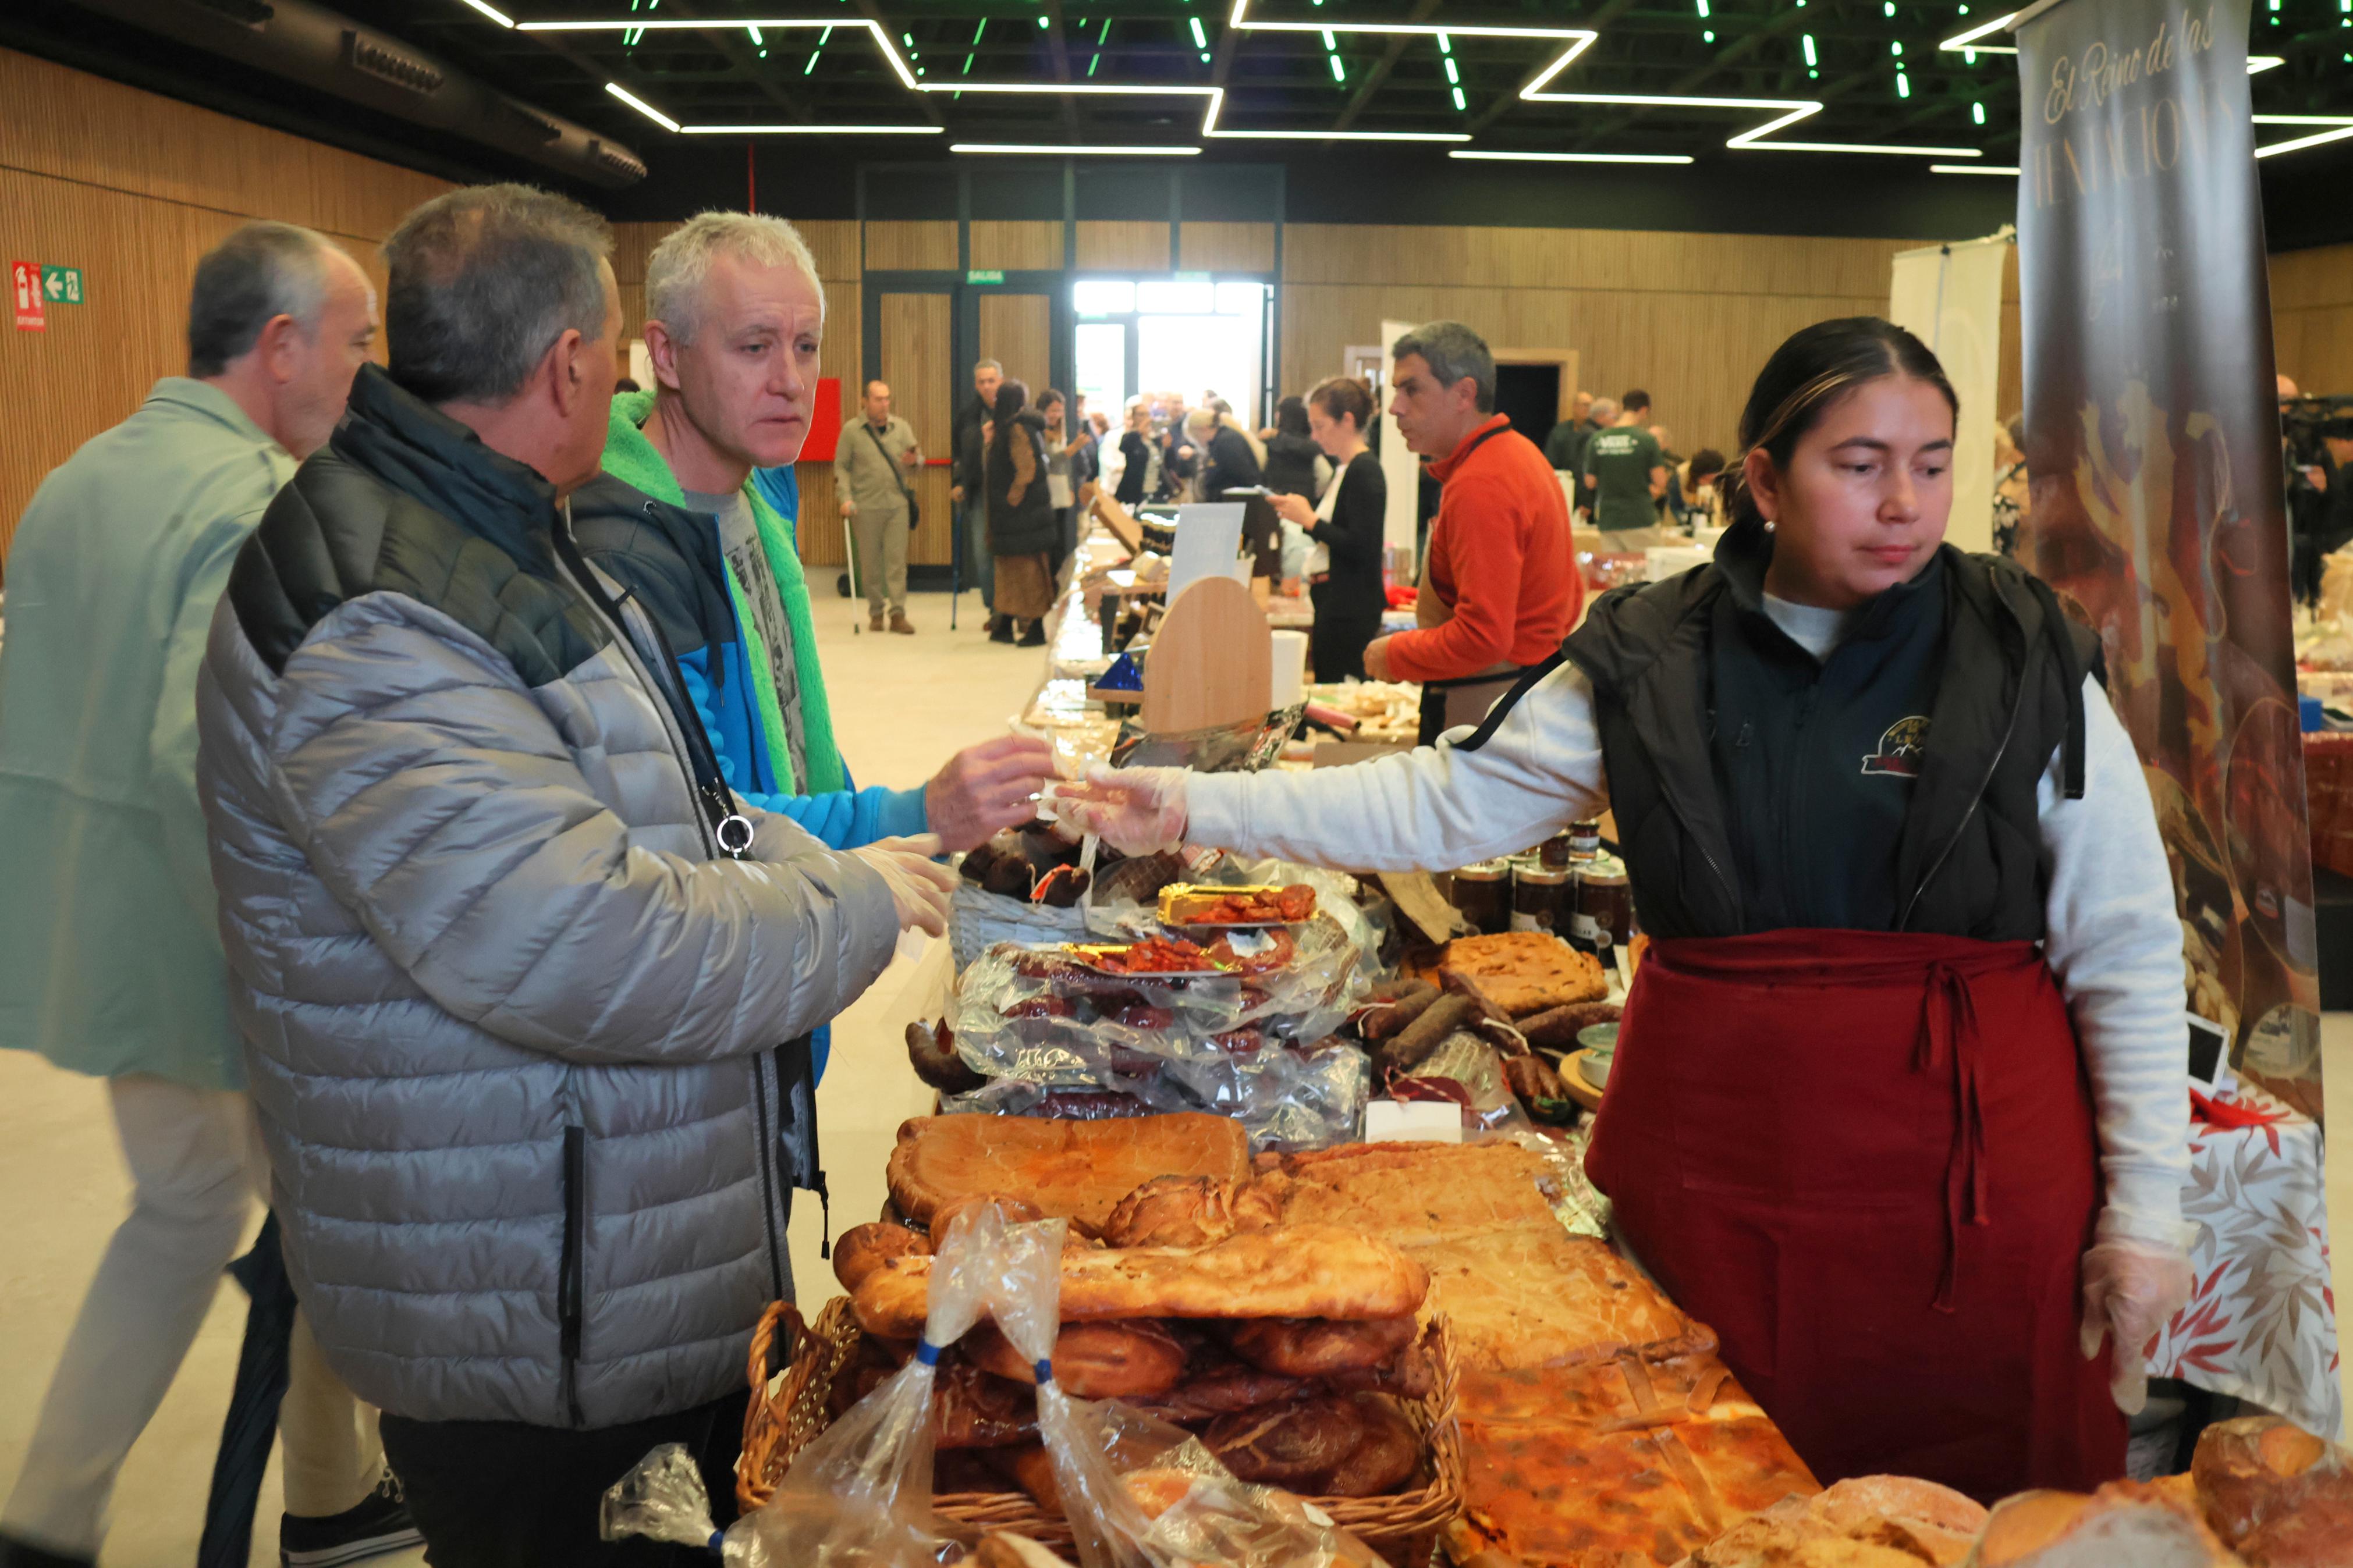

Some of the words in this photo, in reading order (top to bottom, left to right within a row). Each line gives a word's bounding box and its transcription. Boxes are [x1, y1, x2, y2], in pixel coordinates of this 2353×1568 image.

[2044, 55, 2076, 125] El
[2080, 42, 2141, 111] Reino
[2145, 22, 2174, 76] de
[2180, 5, 2214, 62] las
